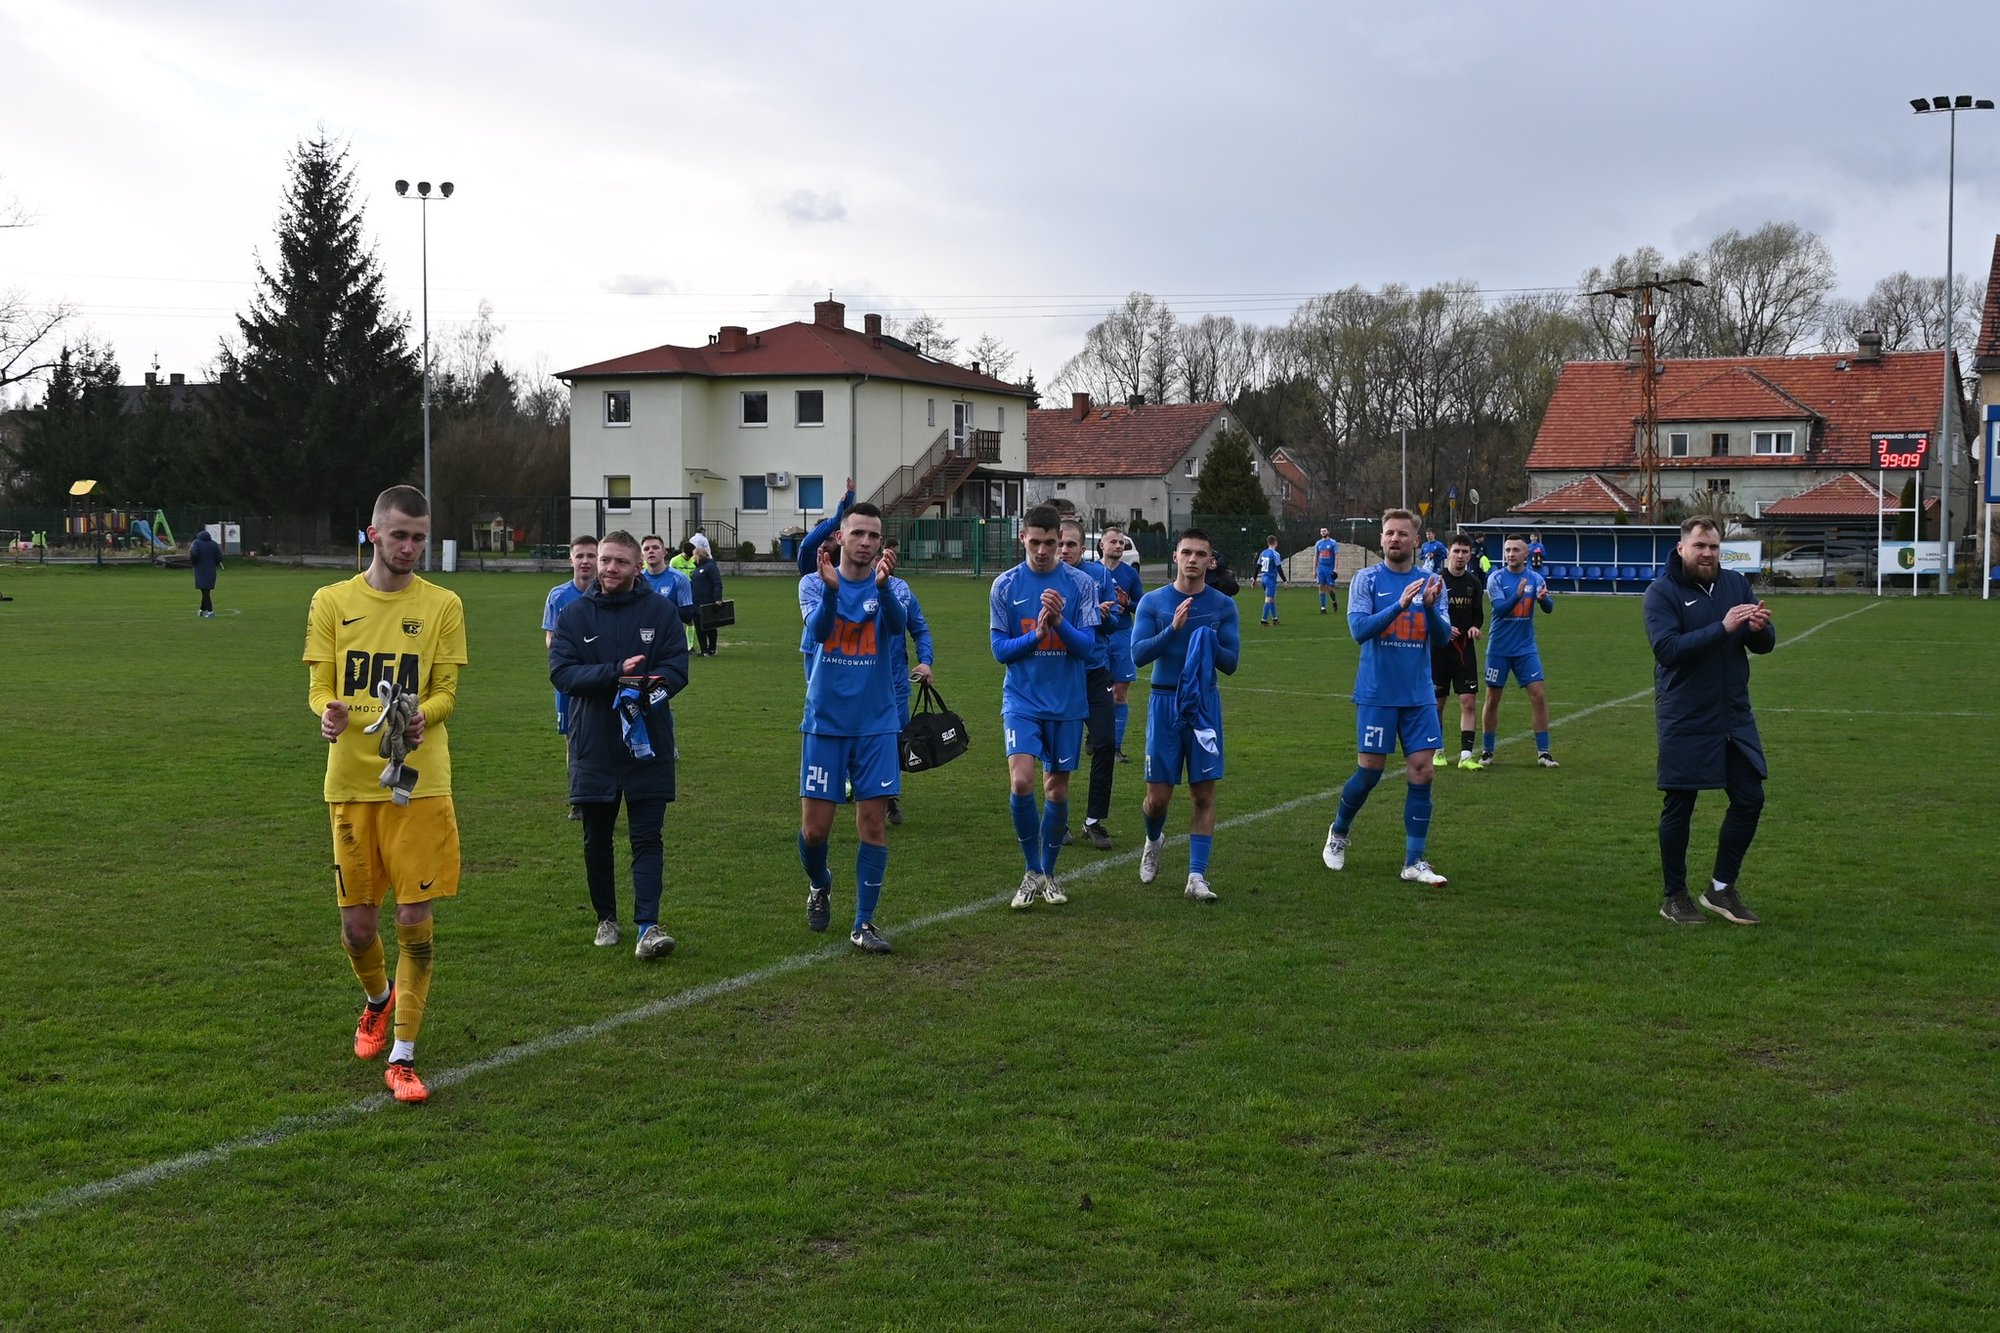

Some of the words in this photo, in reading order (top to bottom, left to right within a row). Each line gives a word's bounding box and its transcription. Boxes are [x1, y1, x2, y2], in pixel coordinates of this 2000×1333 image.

[1878, 440, 1888, 453] 3
[1916, 439, 1927, 453] 3
[1880, 453, 1921, 467] 99:09
[343, 649, 420, 699] PGA
[1485, 667, 1499, 683] 98
[1364, 725, 1384, 748] 27
[805, 765, 829, 793] 24
